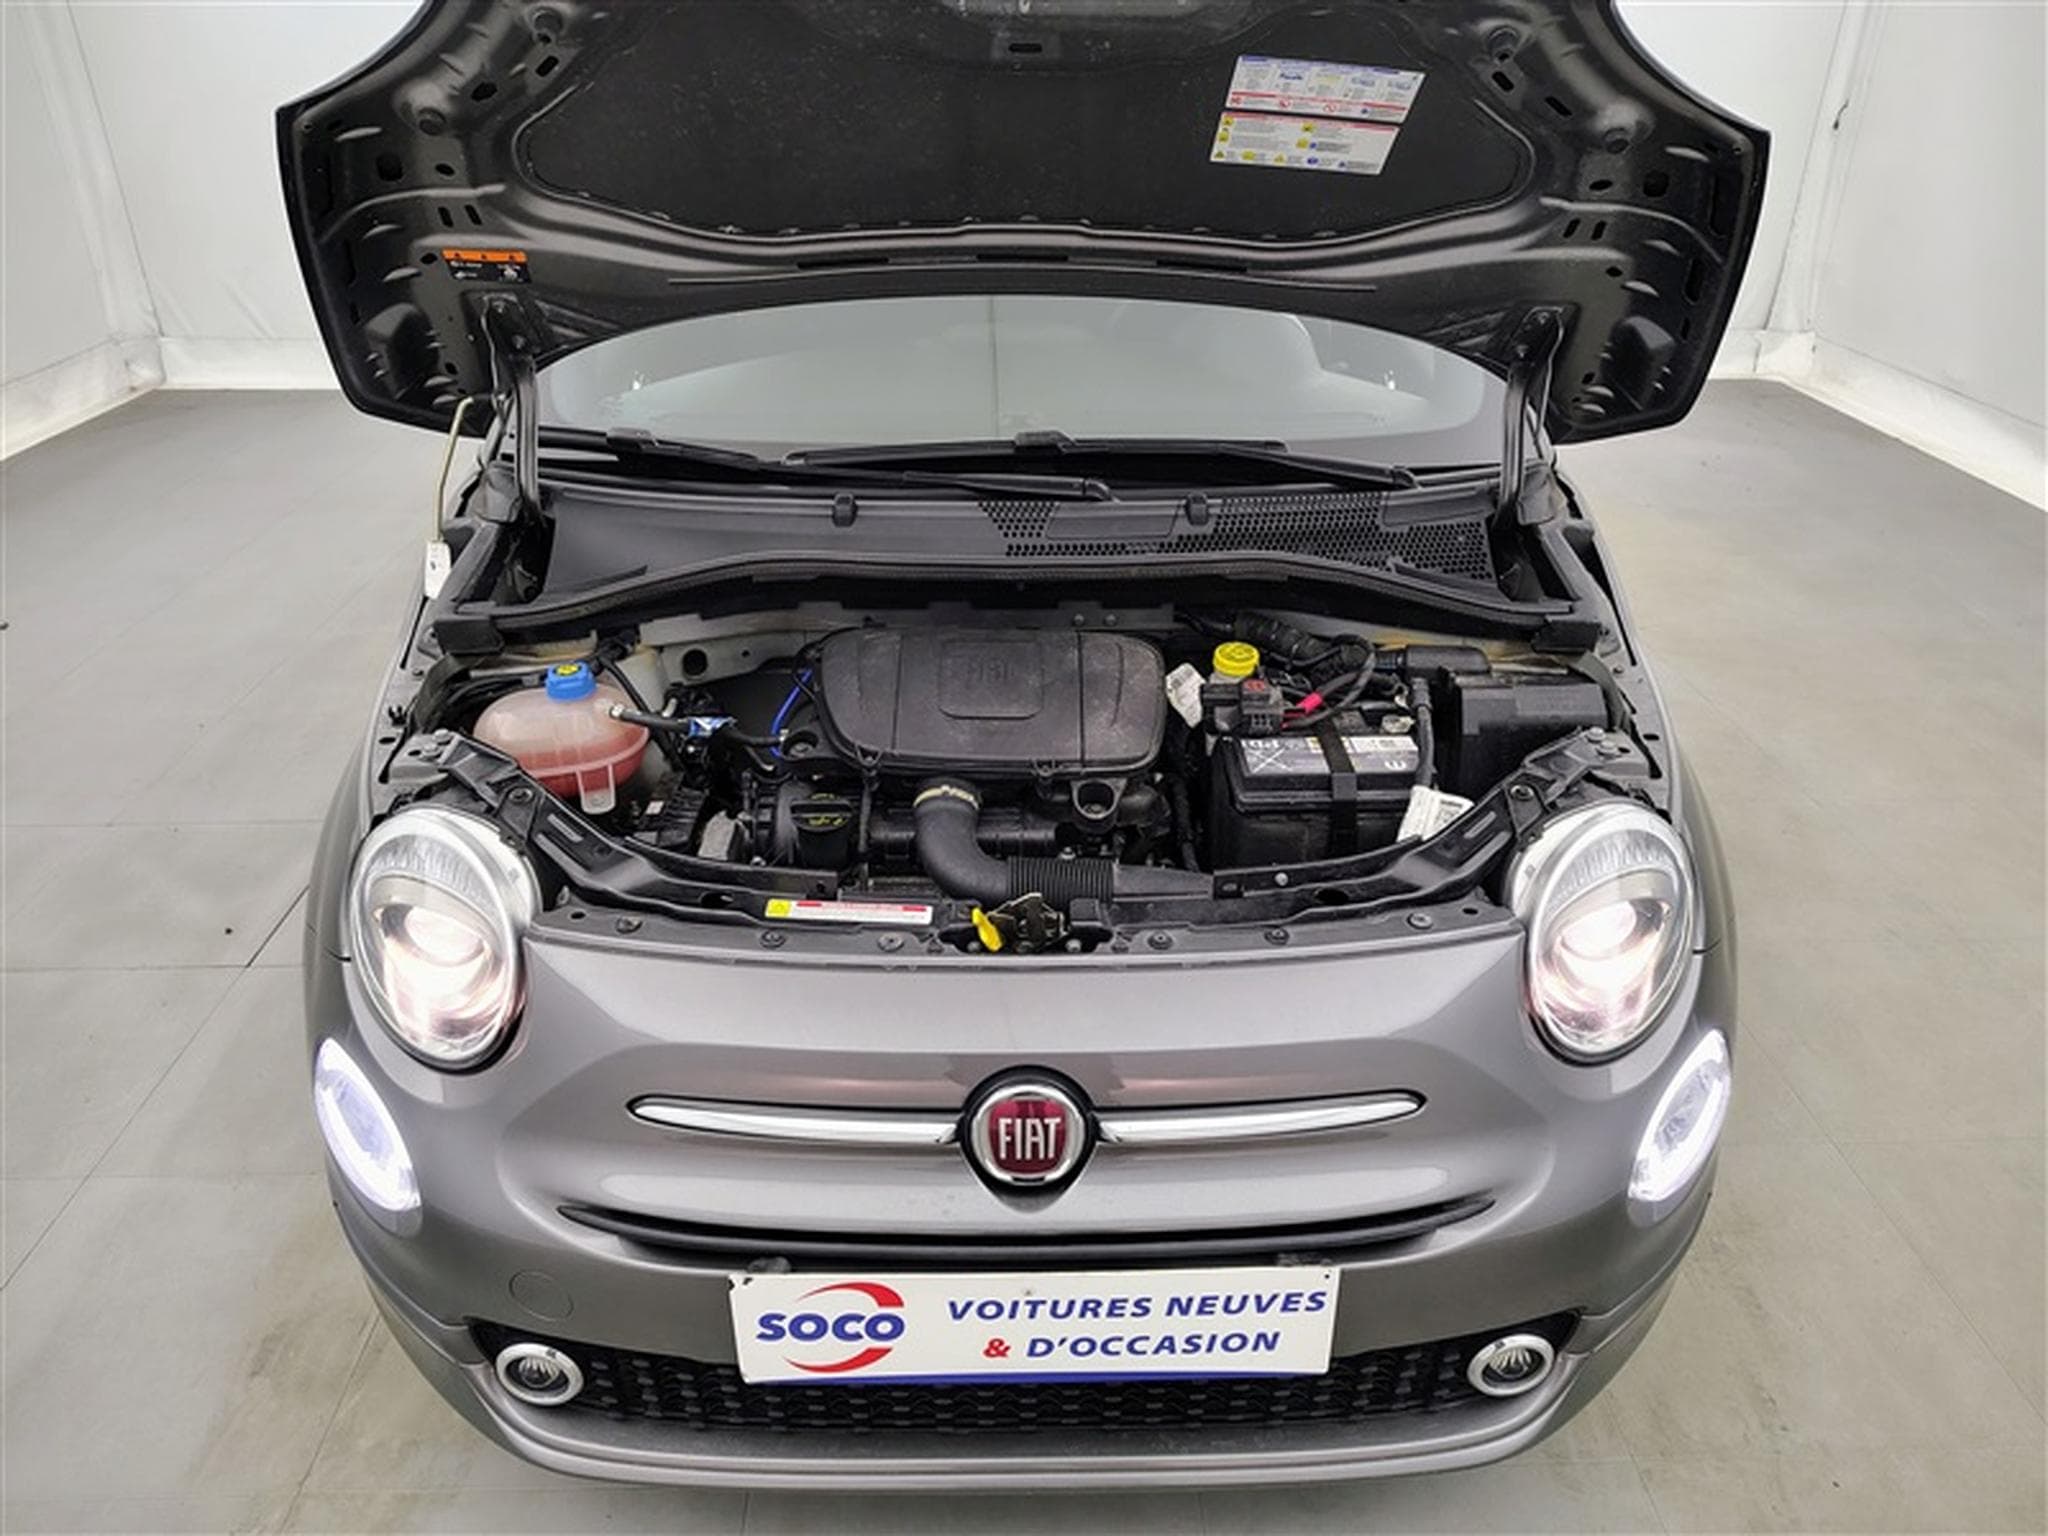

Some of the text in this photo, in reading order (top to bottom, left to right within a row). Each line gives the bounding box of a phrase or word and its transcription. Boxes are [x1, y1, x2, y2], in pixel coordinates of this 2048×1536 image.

[998, 1117, 1061, 1160] FIAT
[948, 1291, 1327, 1320] VOITURES NEUVES
[756, 1312, 905, 1342] SOCO
[983, 1332, 1281, 1358] & D'OCCASION
